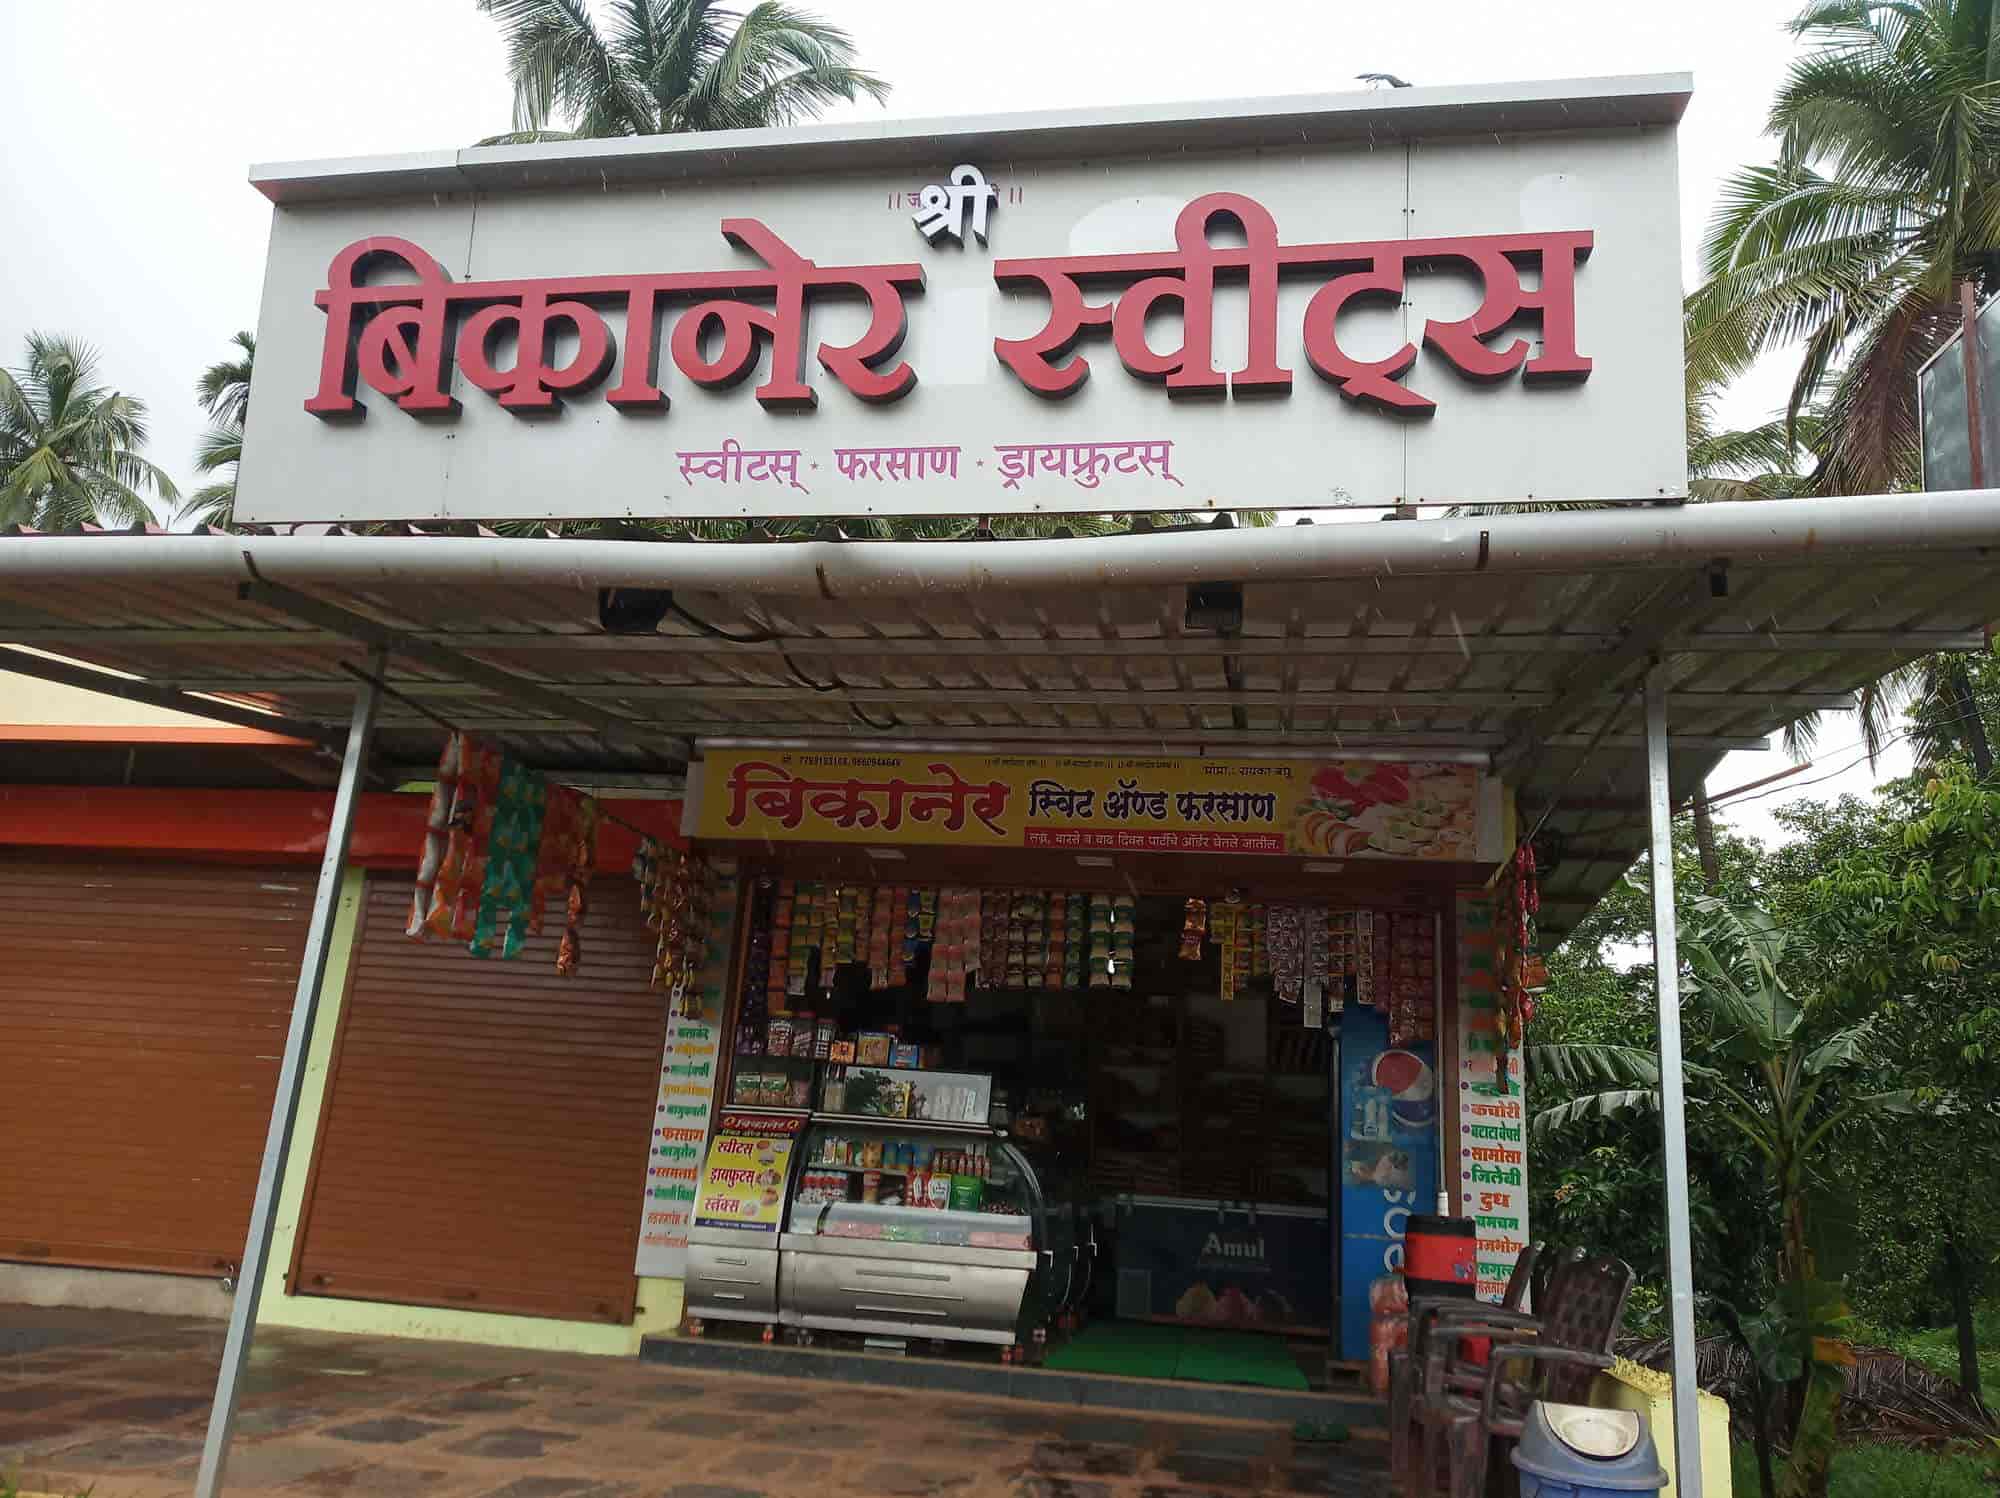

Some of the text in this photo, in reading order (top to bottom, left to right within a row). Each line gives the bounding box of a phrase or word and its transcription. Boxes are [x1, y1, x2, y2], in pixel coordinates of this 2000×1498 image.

[913, 164, 984, 249] श्री
[304, 192, 1594, 421] बिकानेर स्वीट्स
[834, 446, 962, 481] फरसाण
[725, 761, 1012, 836] बिकानेर
[1028, 779, 1095, 818] स्विट
[1175, 790, 1276, 822] फरसाण
[1471, 1100, 1520, 1119] कचोरी
[1472, 1143, 1520, 1165] सामोसा
[1202, 1232, 1265, 1257] Amul
